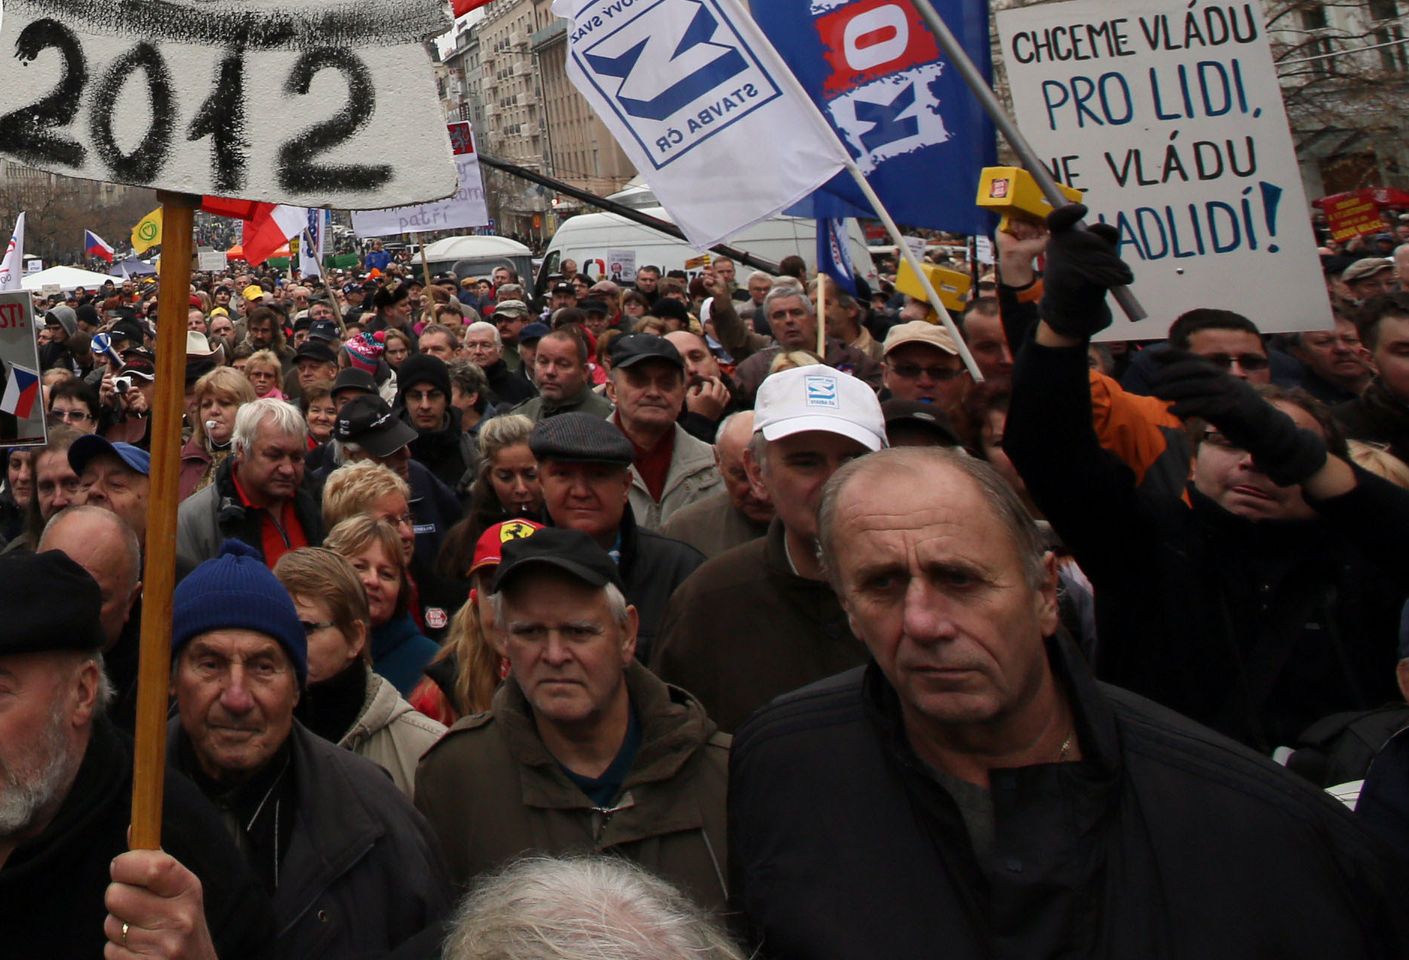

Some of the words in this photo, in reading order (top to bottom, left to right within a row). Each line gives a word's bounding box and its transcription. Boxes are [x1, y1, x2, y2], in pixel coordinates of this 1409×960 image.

[1012, 18, 1136, 64] CHCEME
[1139, 0, 1258, 51] VLÁDU
[1042, 71, 1134, 130] PRO
[1149, 58, 1262, 120] LIDI,
[1104, 130, 1257, 188] VLÁDU
[1098, 181, 1284, 261] ADLIDÍ!
